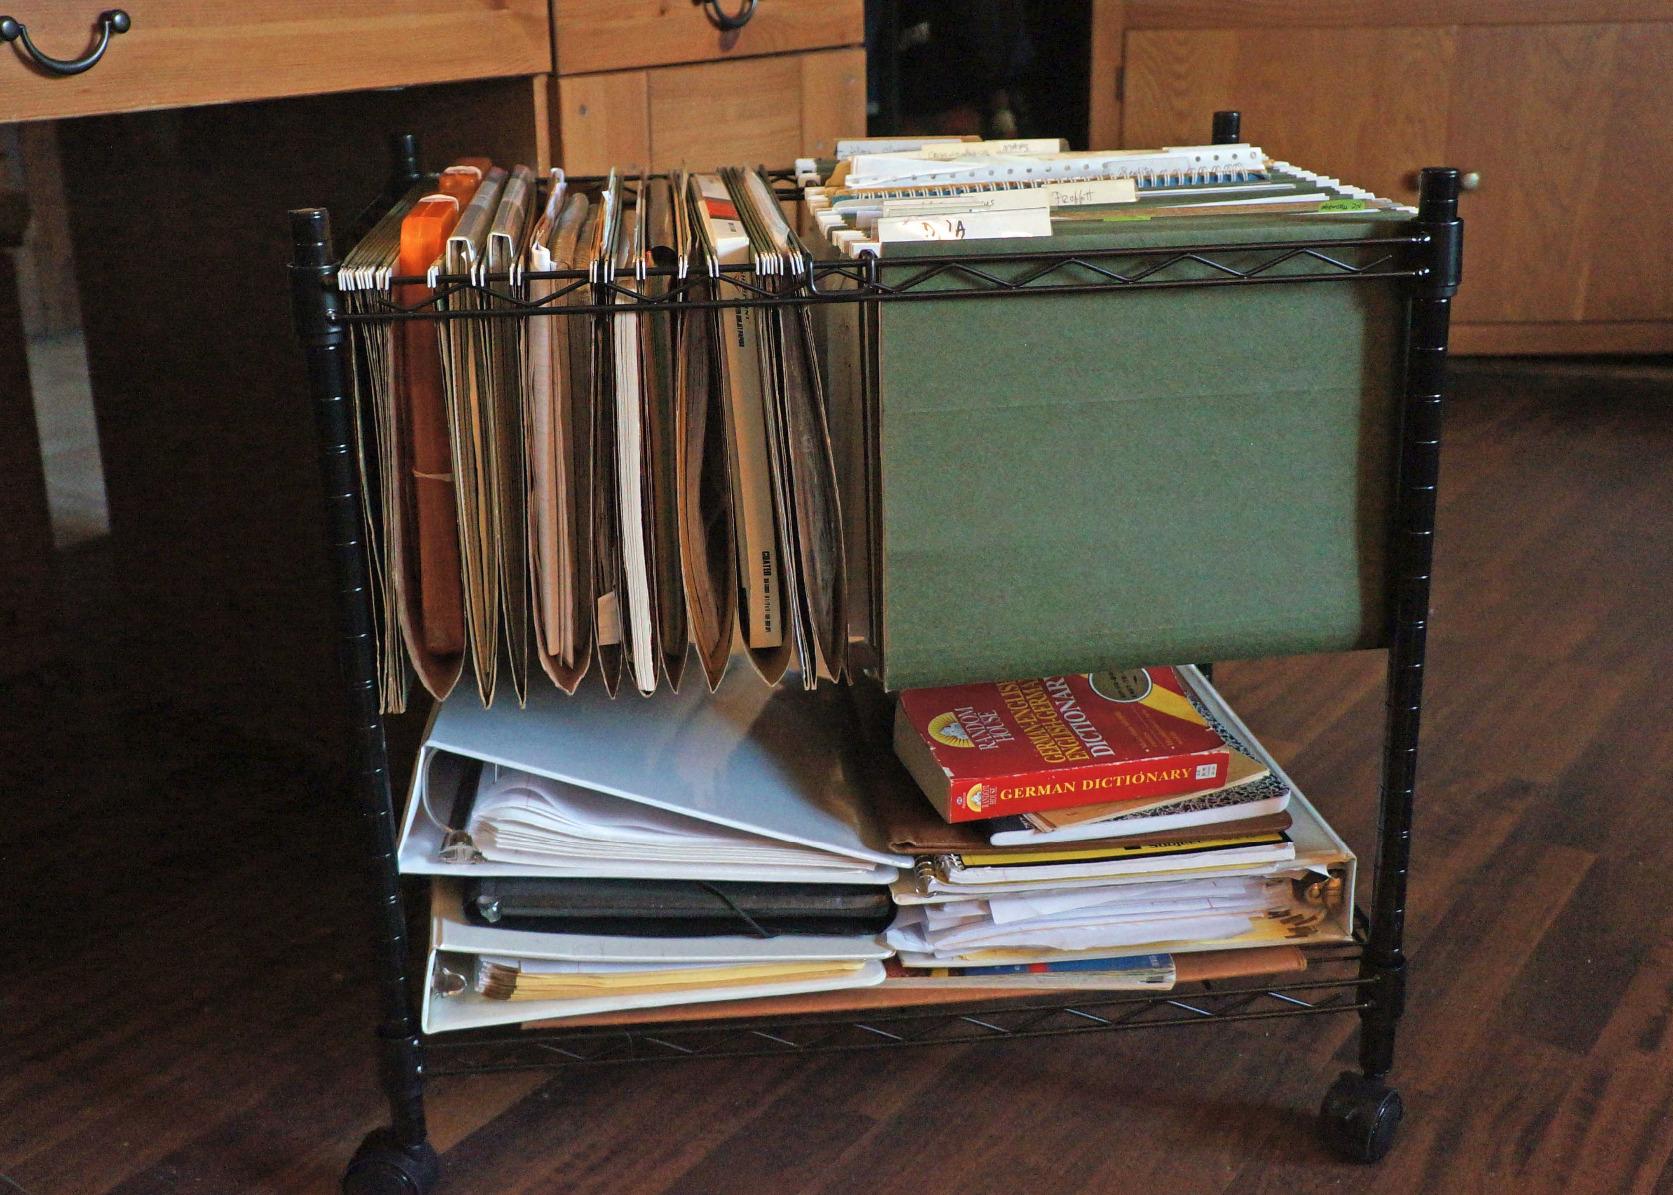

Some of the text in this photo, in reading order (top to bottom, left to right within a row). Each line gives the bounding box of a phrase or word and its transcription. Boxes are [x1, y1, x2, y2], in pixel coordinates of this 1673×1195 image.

[954, 706, 999, 751] RANDOM
[977, 709, 1015, 742] HOUSE
[1019, 678, 1089, 762] ENGLISH-GERMA
[1000, 780, 1076, 801] GERMAN
[1081, 767, 1193, 791] DICTIONARY
